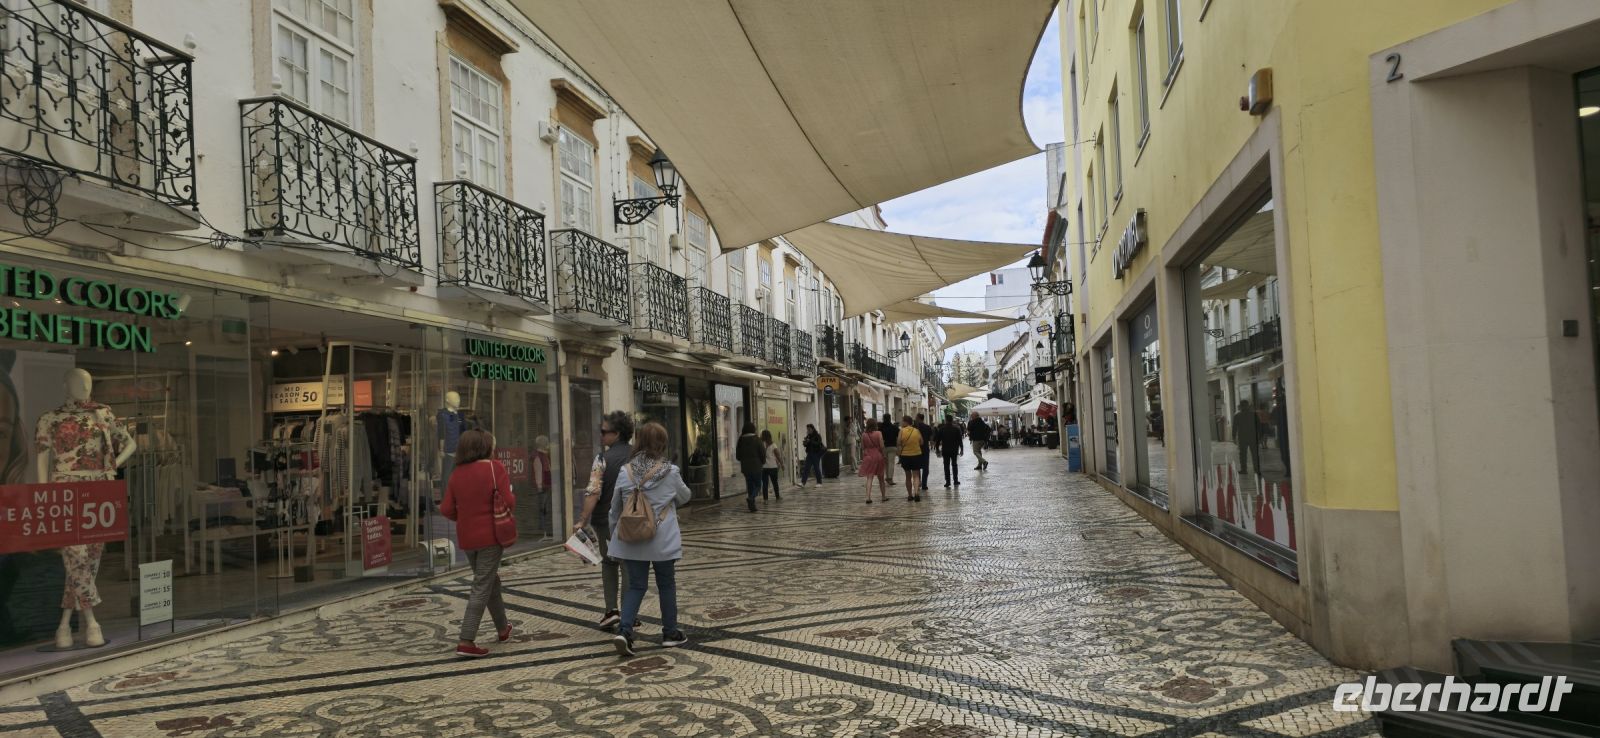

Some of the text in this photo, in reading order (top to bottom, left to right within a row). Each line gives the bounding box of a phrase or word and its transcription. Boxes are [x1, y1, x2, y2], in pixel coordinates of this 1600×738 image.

[1385, 52, 1404, 84] 2
[63, 276, 181, 320] COLORS
[469, 338, 546, 363] UNITED COLORS
[470, 361, 486, 378] OF
[34, 489, 74, 505] MID
[0, 503, 73, 522] EASON
[23, 518, 73, 536] SALE
